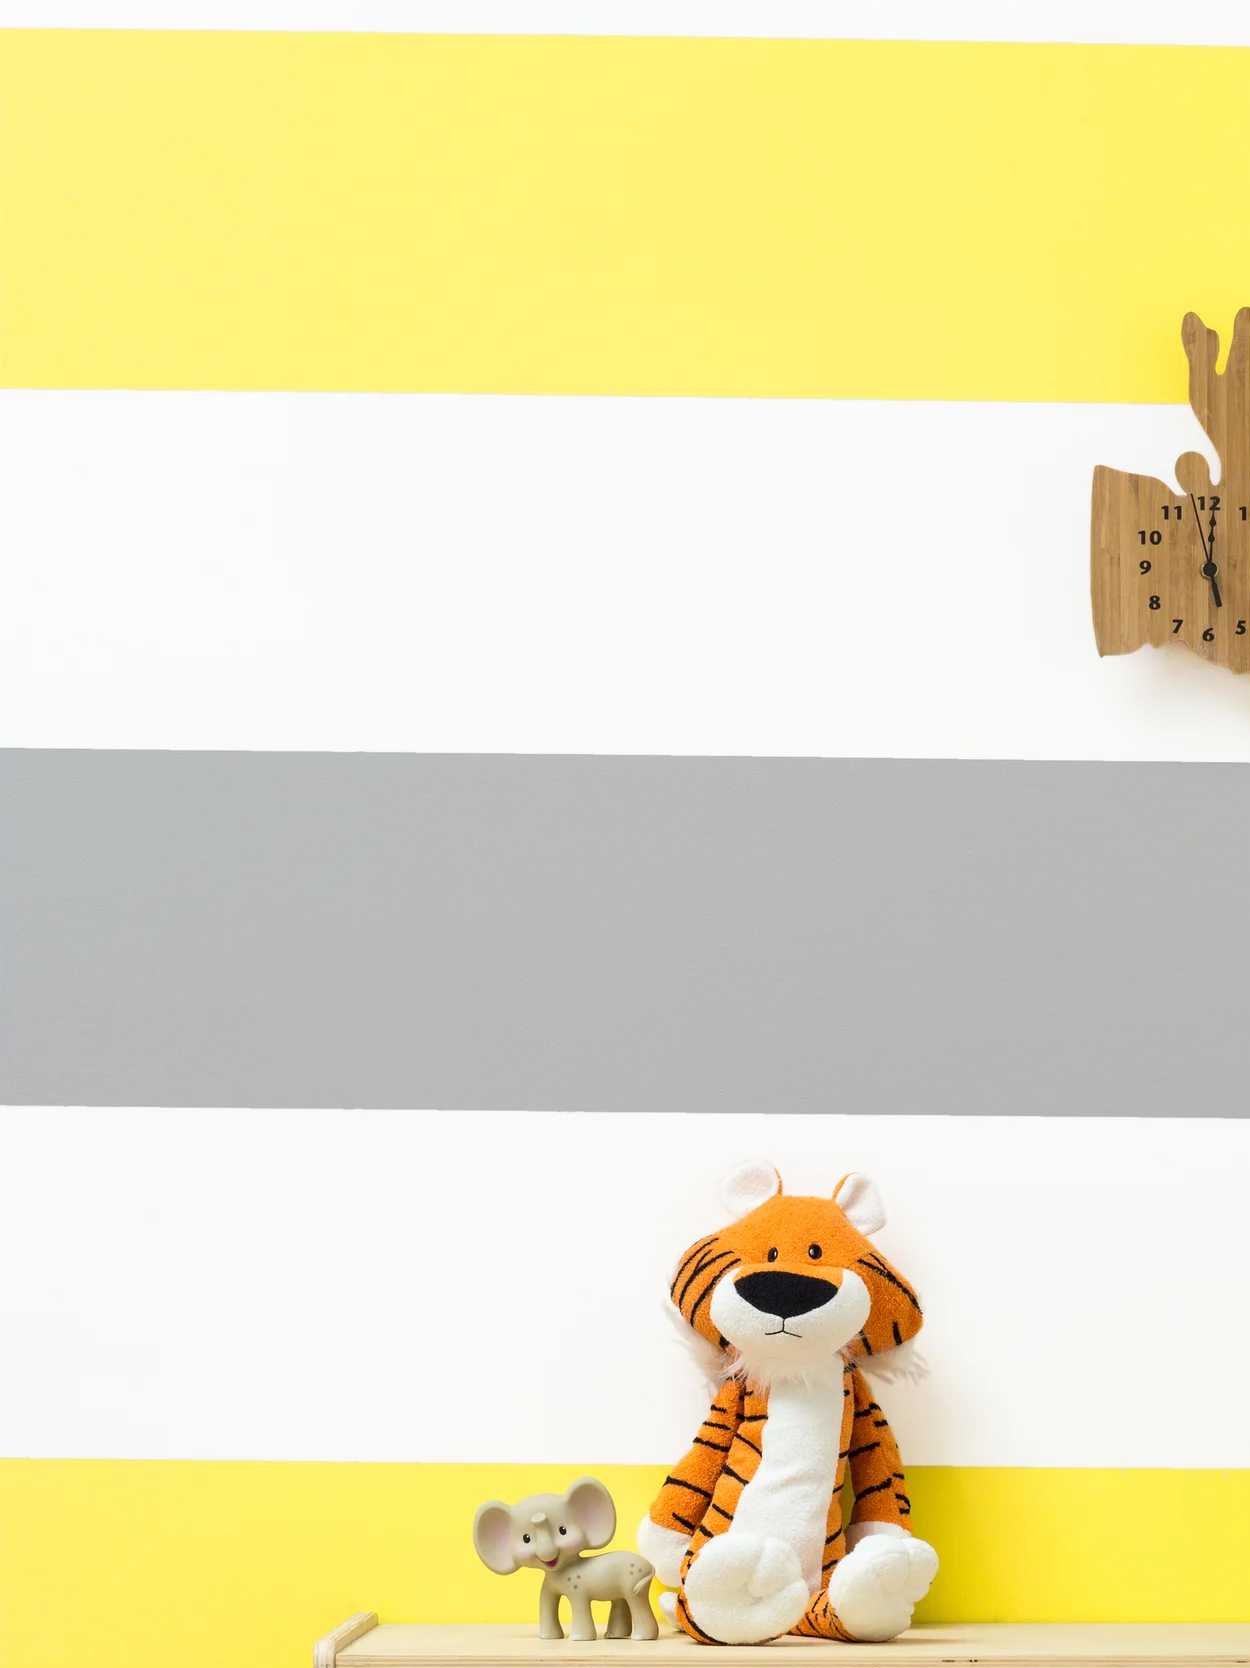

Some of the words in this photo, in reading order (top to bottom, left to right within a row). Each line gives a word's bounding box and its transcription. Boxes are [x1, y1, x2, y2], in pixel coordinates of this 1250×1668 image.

[1197, 496, 1221, 511] 12
[1161, 505, 1182, 520] 11
[1238, 506, 1247, 521] 1
[1138, 530, 1162, 545] 10
[1139, 560, 1152, 575] 9
[1148, 595, 1161, 610] 8
[1172, 619, 1184, 634] 7
[1235, 620, 1246, 635] 5
[1202, 627, 1215, 642] 6
